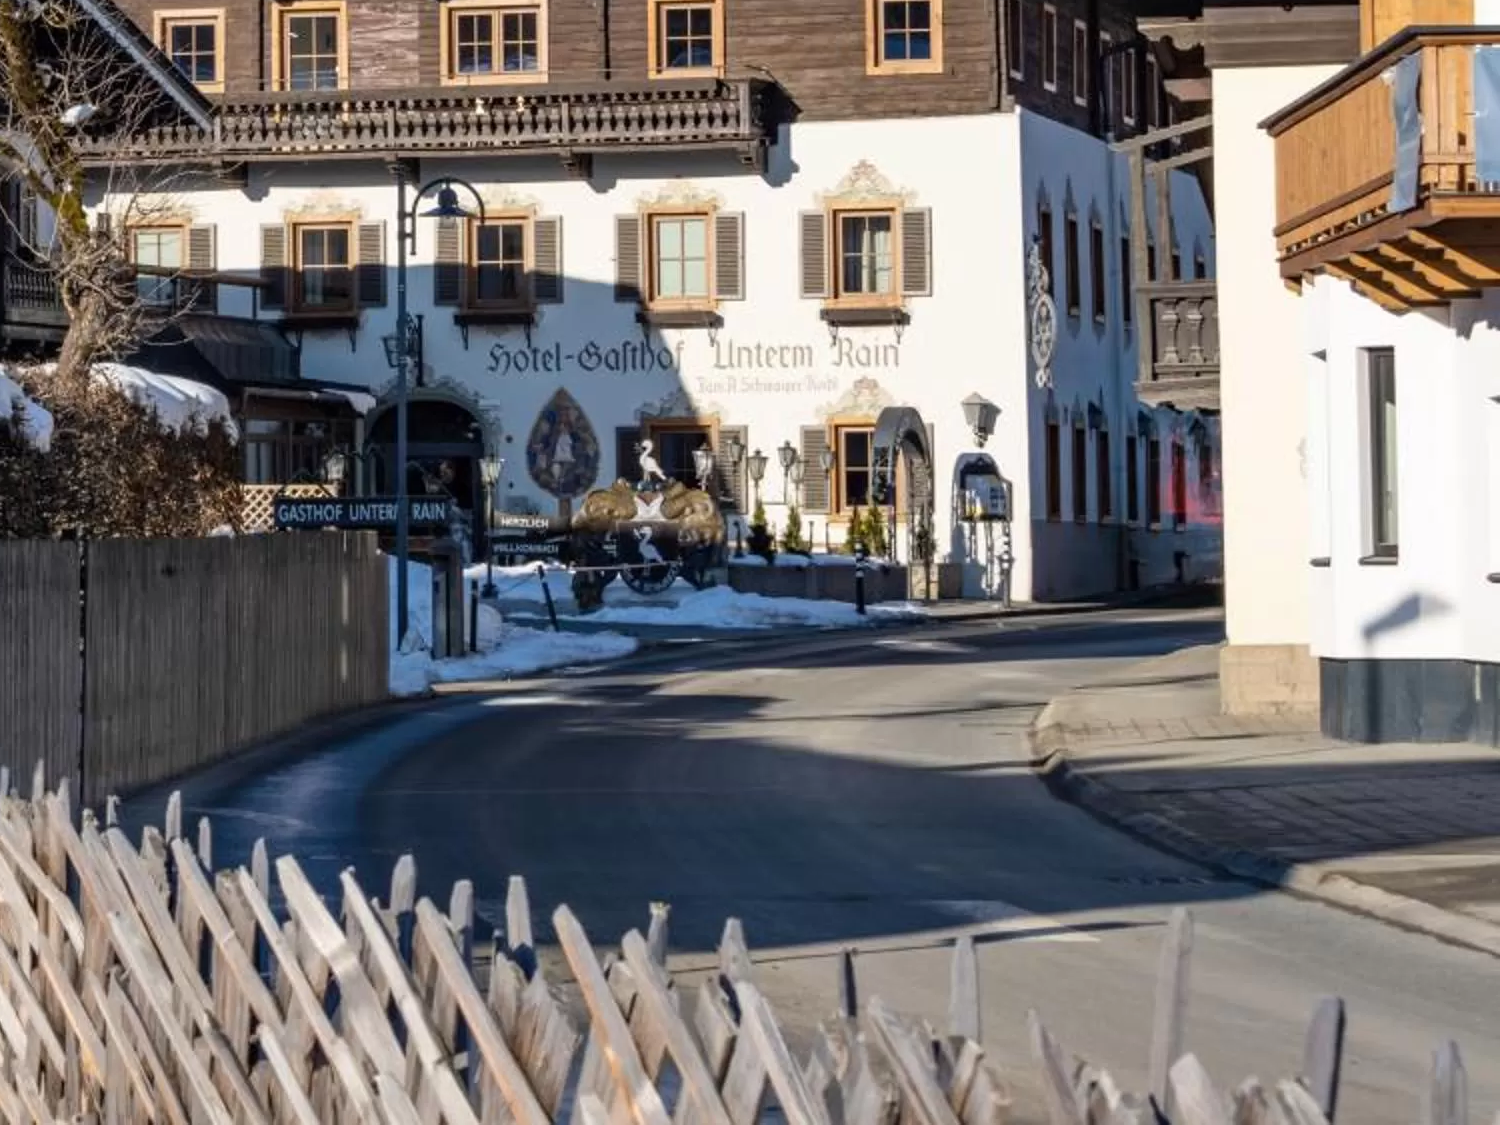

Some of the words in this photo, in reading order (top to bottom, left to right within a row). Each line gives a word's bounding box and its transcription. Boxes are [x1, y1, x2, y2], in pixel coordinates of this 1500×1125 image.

[712, 337, 814, 369] Unterm
[830, 335, 900, 368] Rain
[278, 503, 344, 523] GASTHOF
[412, 501, 446, 521] RAIN
